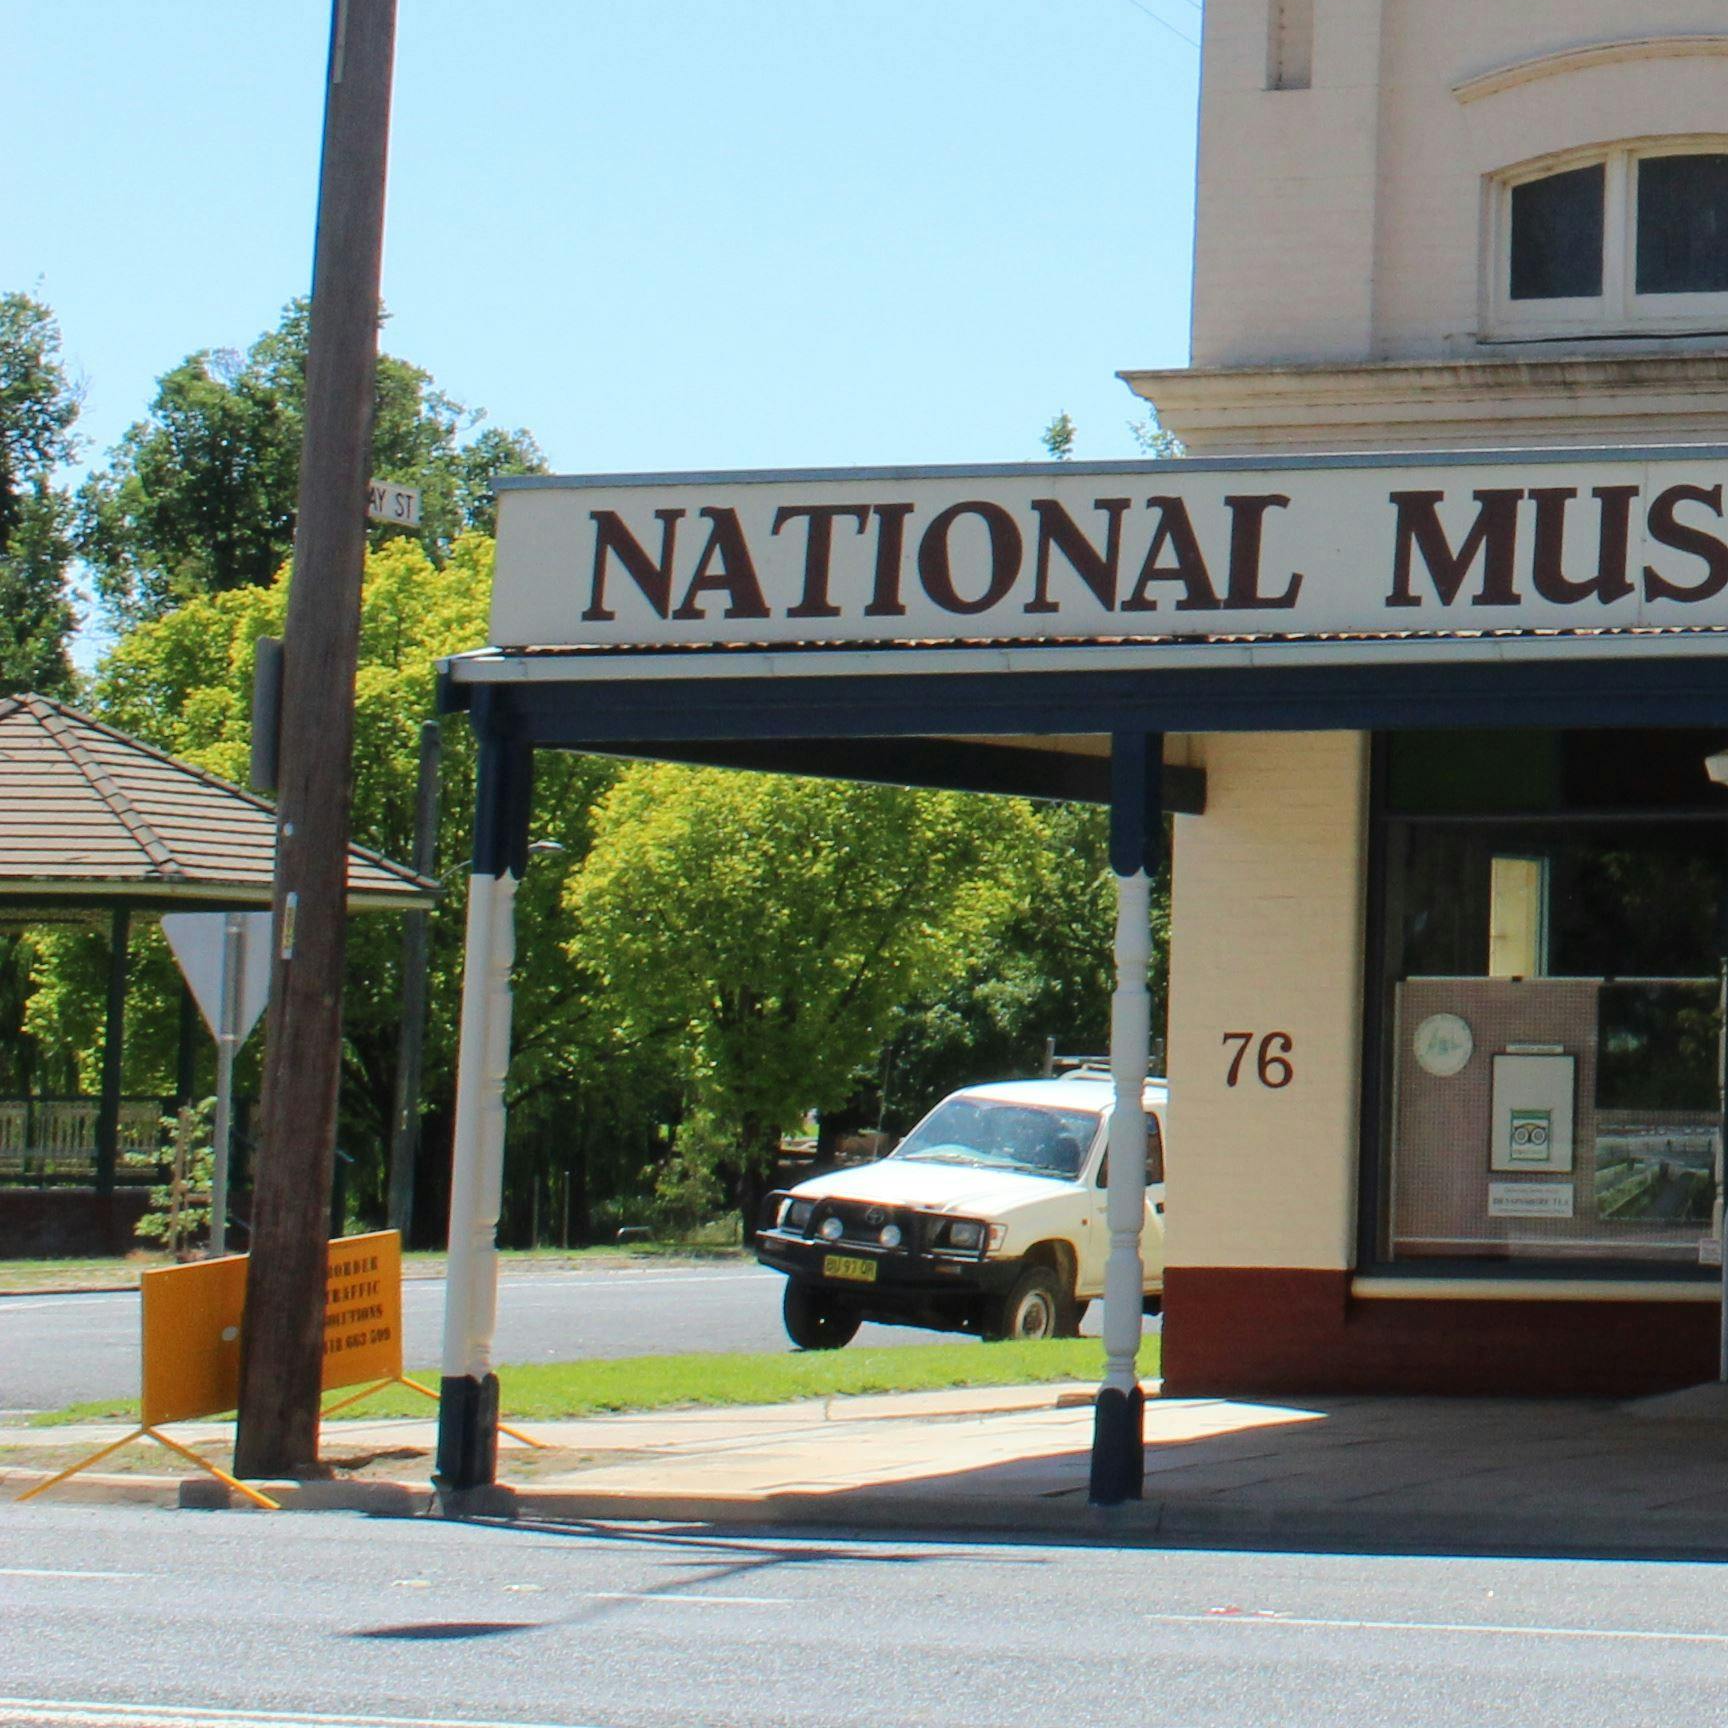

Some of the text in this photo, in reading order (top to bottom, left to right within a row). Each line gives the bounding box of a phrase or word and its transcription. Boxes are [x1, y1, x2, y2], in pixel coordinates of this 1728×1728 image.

[394, 492, 415, 519] ST
[581, 493, 1304, 622] NATIONAL
[1221, 1030, 1295, 1089] 76
